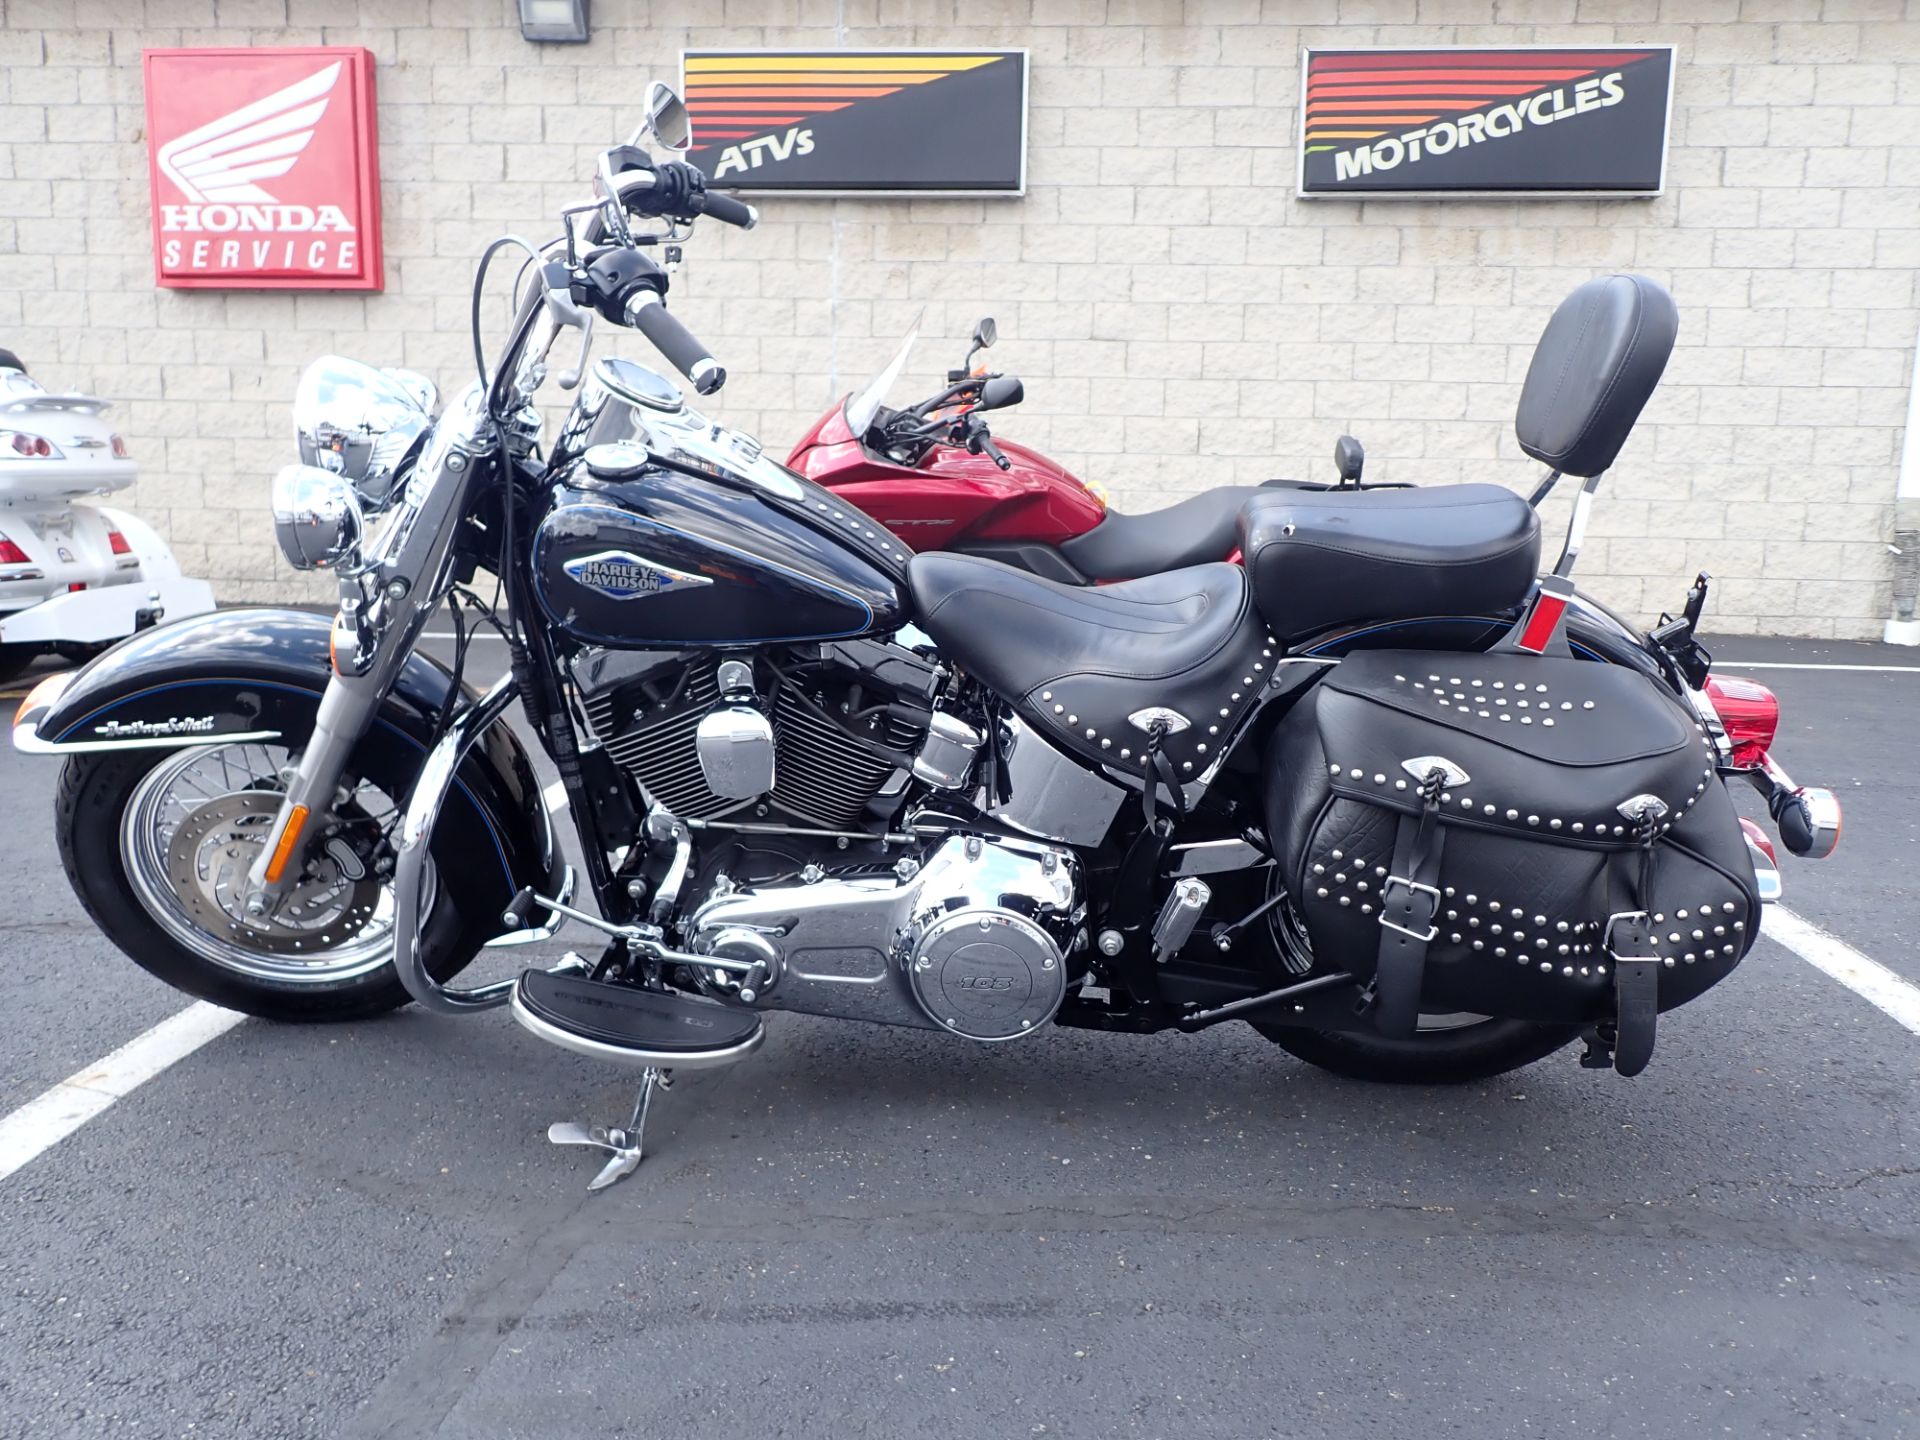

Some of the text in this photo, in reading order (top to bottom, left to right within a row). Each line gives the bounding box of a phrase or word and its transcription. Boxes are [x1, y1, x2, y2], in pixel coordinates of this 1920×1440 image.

[1335, 72, 1625, 182] MOTORCYCLES
[160, 205, 356, 232] HONDA
[163, 239, 356, 269] SERVICE
[581, 572, 660, 591] DAVIDSON
[960, 975, 1015, 991] 103
